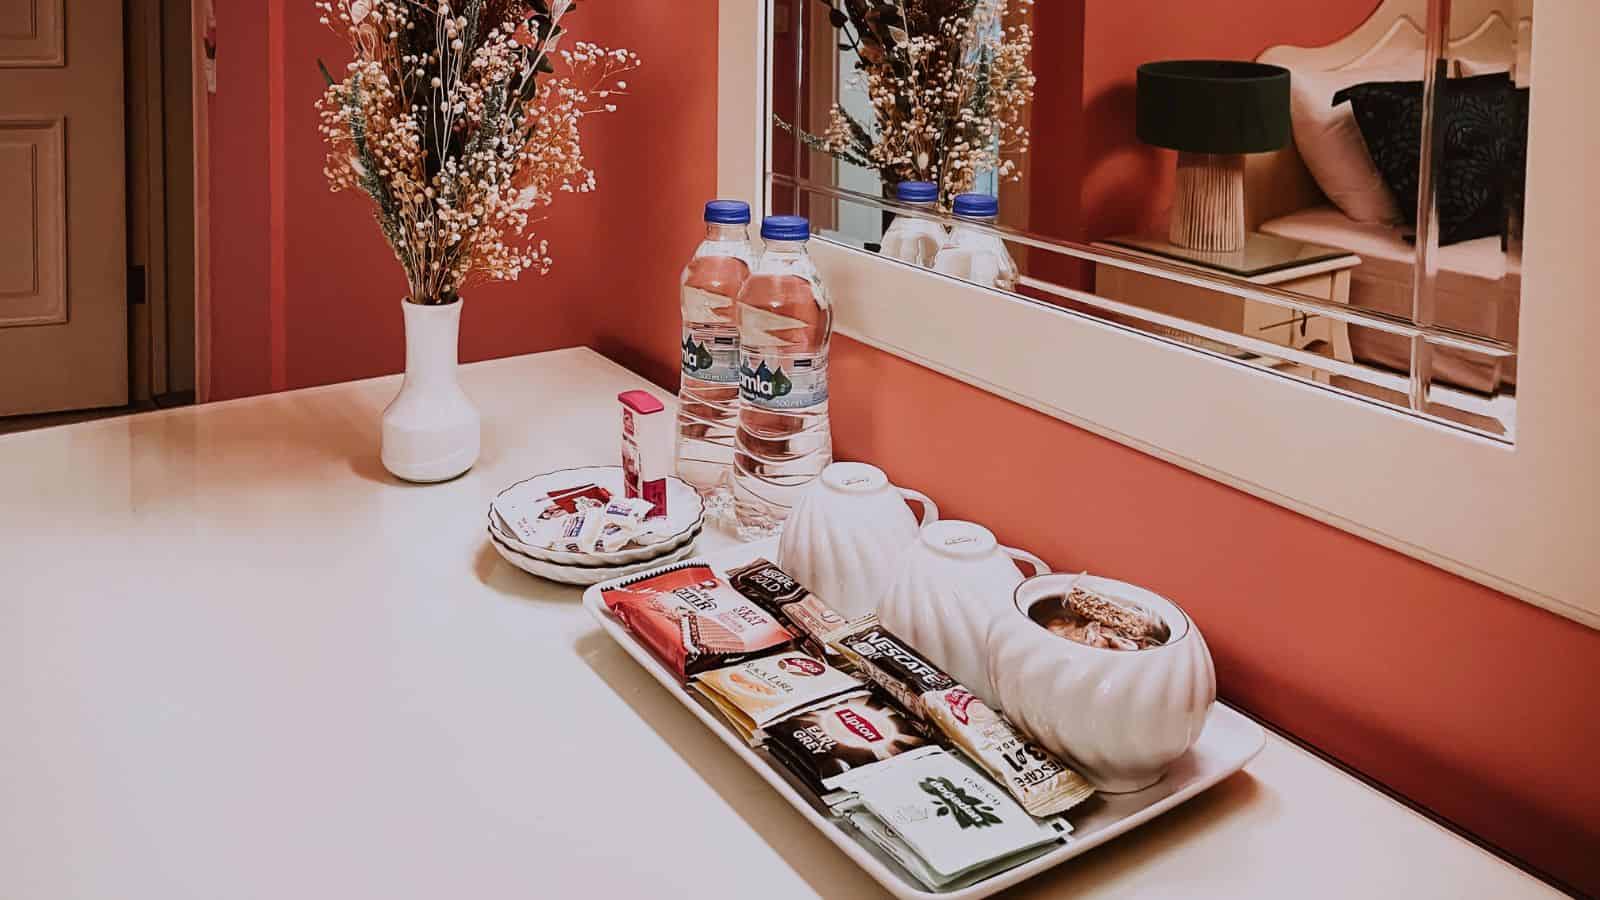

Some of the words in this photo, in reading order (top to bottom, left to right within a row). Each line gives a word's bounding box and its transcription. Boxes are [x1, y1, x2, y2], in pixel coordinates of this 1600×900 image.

[750, 574, 781, 593] GOLD
[807, 725, 837, 750] EARL
[843, 710, 877, 741] Lipton
[792, 730, 827, 755] GREY
